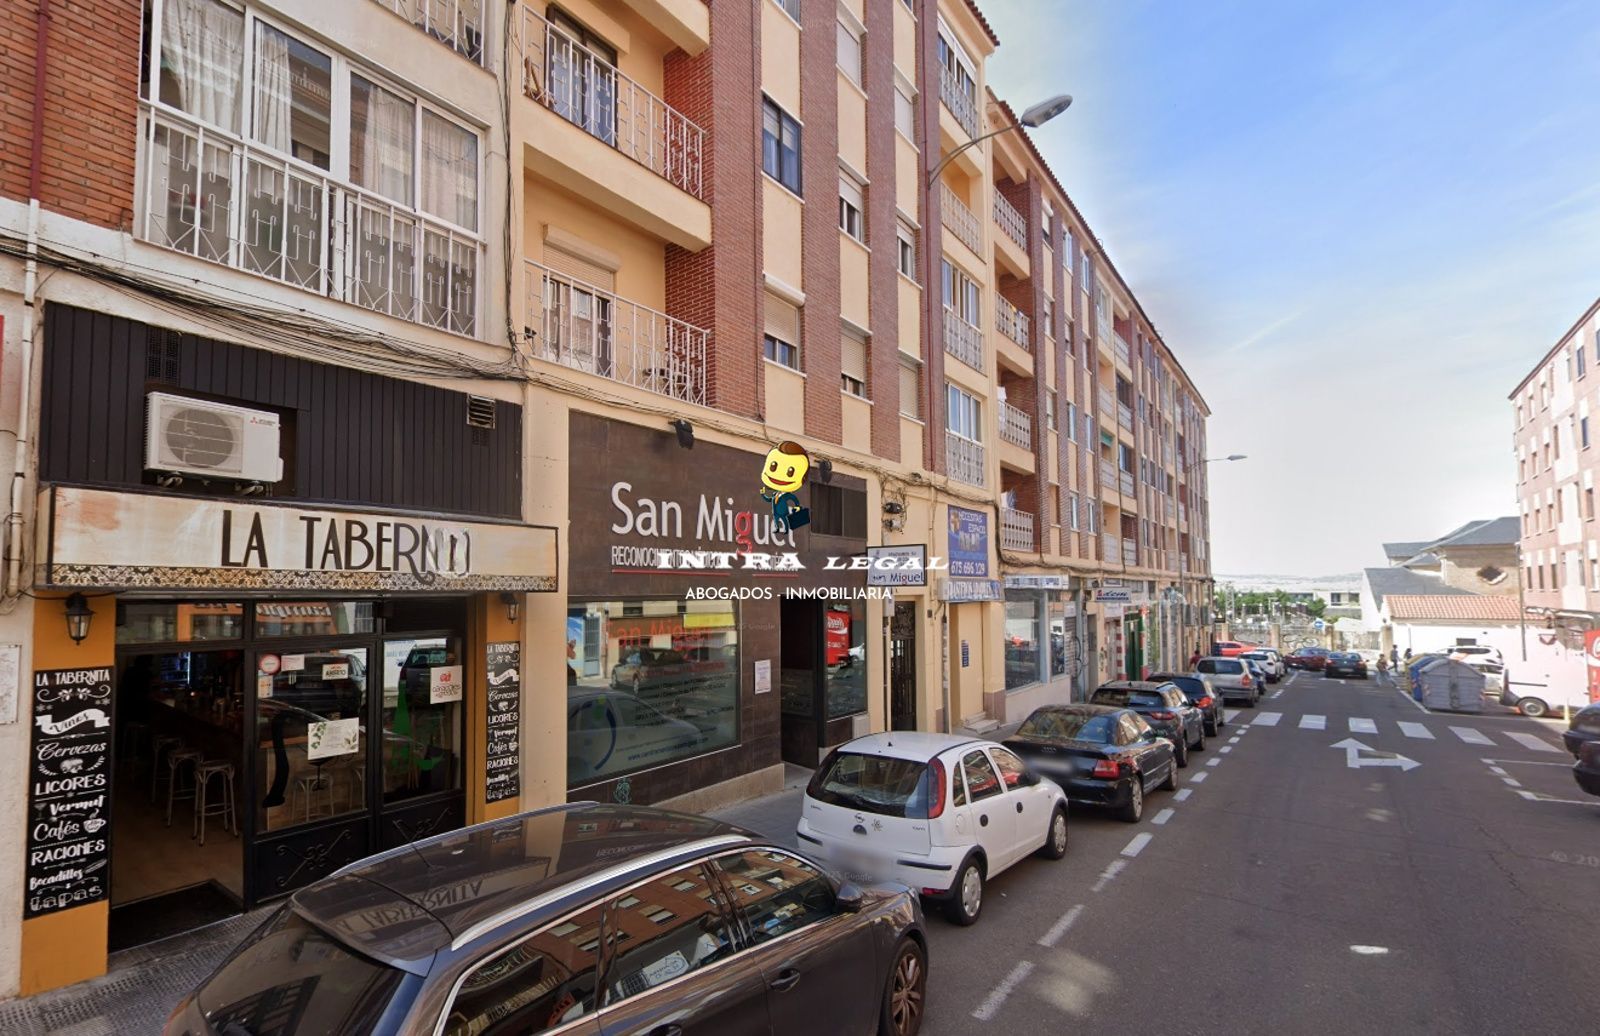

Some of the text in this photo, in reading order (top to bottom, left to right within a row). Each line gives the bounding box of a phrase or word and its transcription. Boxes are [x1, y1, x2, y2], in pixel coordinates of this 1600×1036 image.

[612, 481, 682, 538] San
[221, 510, 268, 567] LA
[890, 572, 923, 585] Miguel
[36, 669, 110, 686] LA TABERNITA
[36, 742, 107, 760] Cervezas
[35, 773, 106, 795] LICORES
[50, 795, 107, 815] Vermut
[33, 820, 80, 841] Cafés
[31, 839, 105, 866] RACIONES
